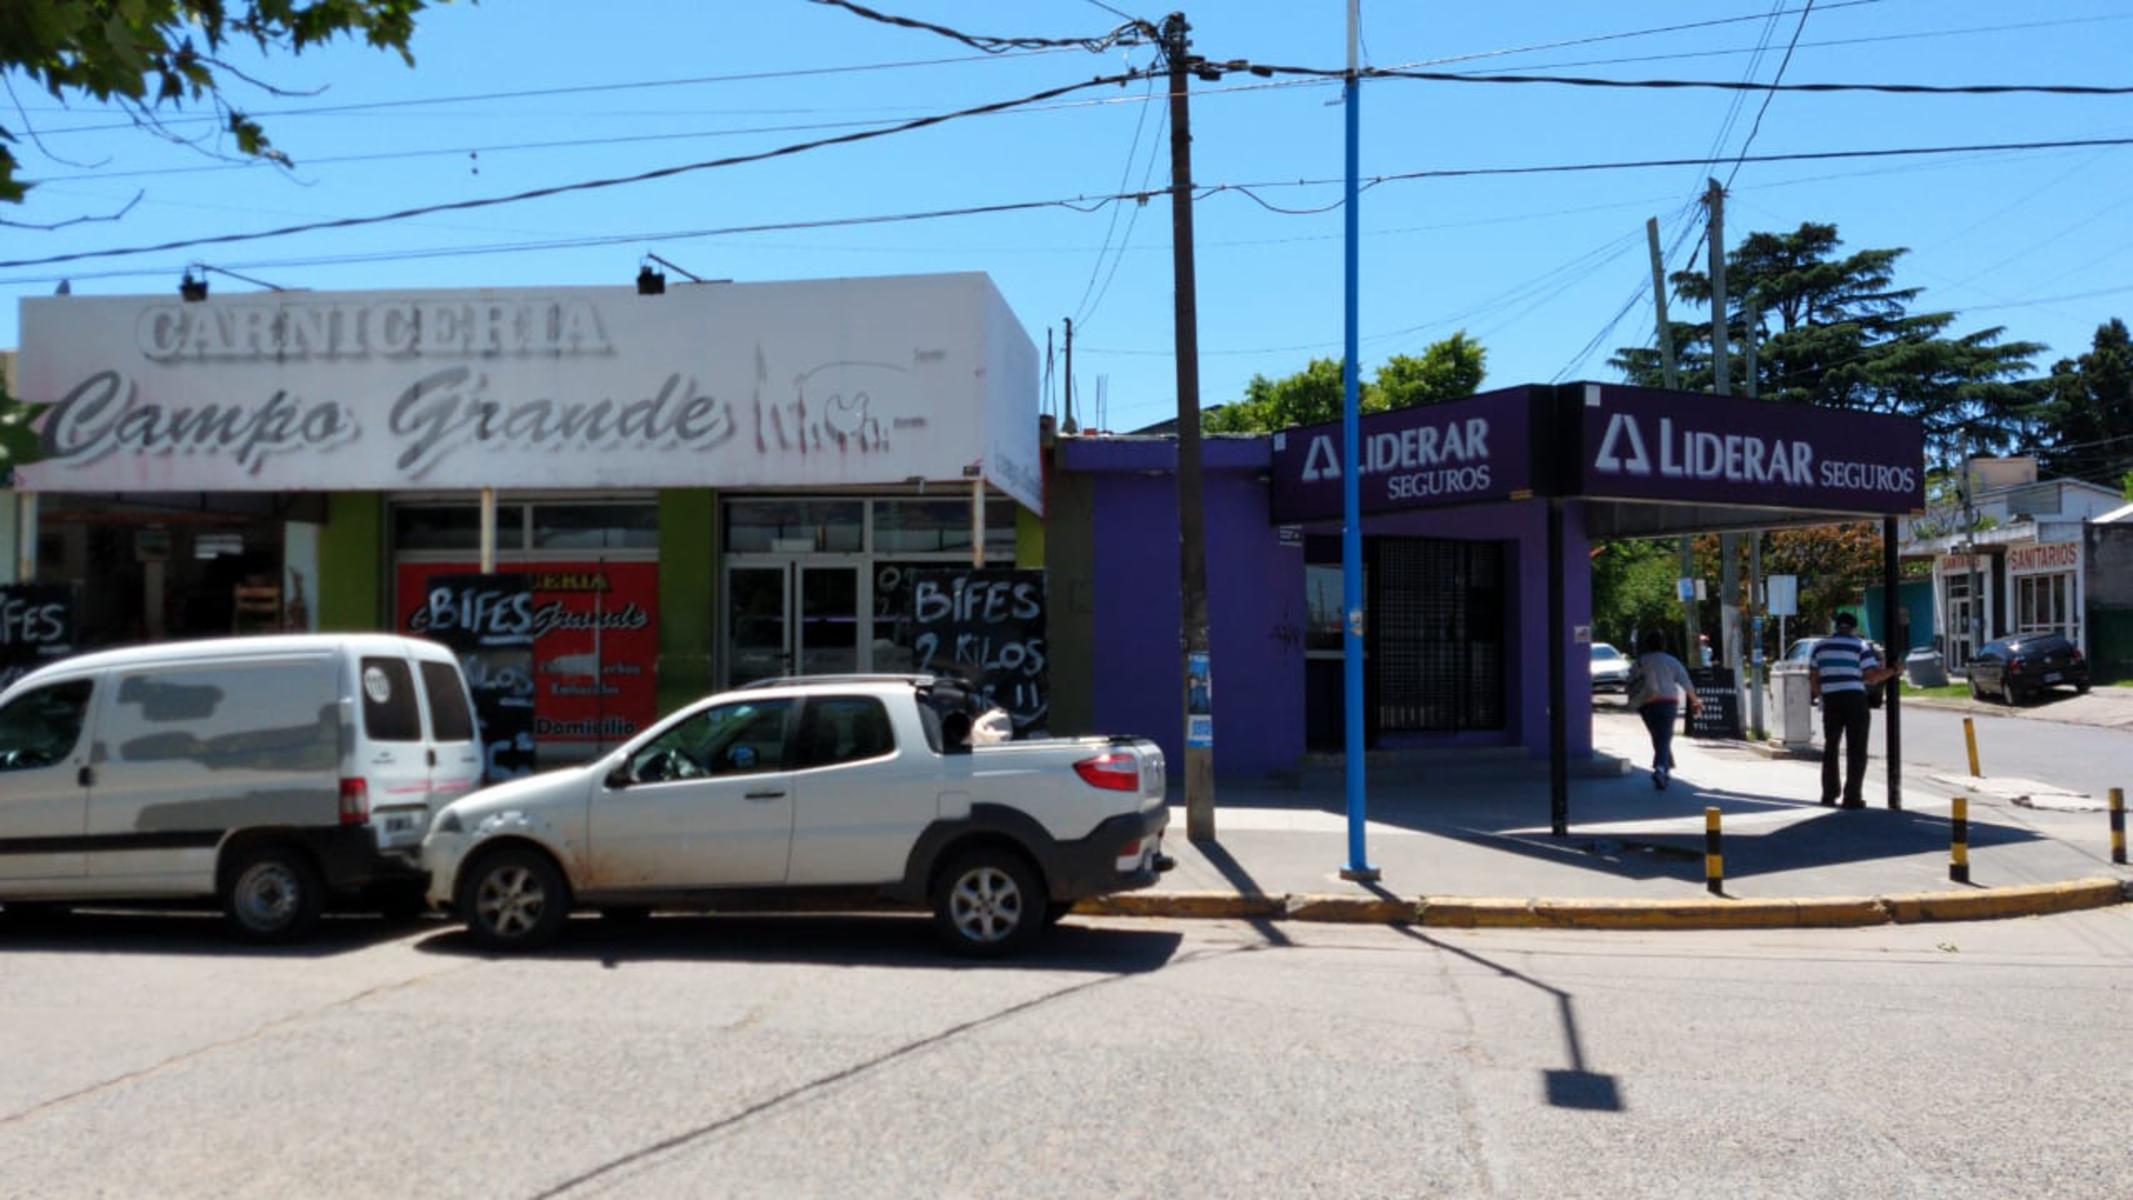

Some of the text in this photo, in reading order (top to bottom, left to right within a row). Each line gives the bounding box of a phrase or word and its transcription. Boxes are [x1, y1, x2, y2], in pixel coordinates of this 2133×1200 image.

[136, 300, 616, 363] CARNICERIA
[38, 366, 738, 480] Campo Grande
[1659, 417, 1916, 492] LIDERAR SEGUROS
[1387, 465, 1491, 500] SEGUROS
[2010, 543, 2077, 571] SANITARIOS
[0, 597, 65, 644] FES
[428, 587, 533, 634] BIFES
[914, 577, 1041, 624] BIFES
